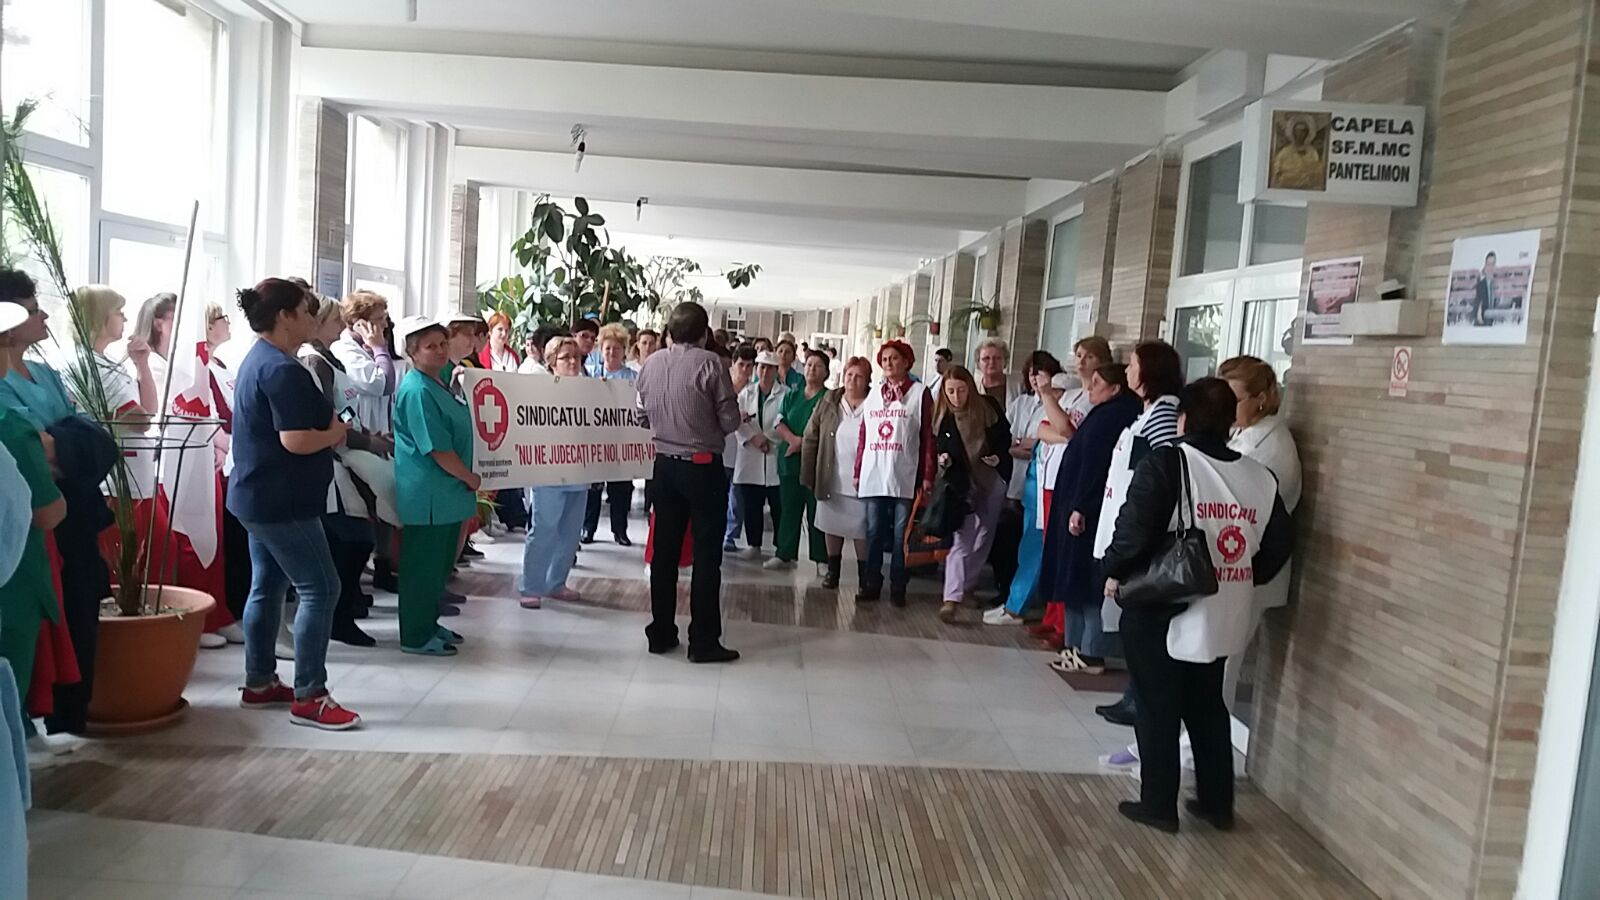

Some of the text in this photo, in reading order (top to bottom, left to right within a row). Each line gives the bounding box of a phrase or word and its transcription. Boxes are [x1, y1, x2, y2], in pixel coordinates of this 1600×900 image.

[1331, 116, 1414, 135] CAPELA
[1331, 140, 1411, 158] SF.M.MC
[1328, 162, 1411, 182] PANTELIMON
[516, 404, 640, 427] SINDICATUL SANITAS
[869, 408, 908, 419] SINDICATUL
[535, 444, 547, 465] NE
[591, 444, 602, 464] PE
